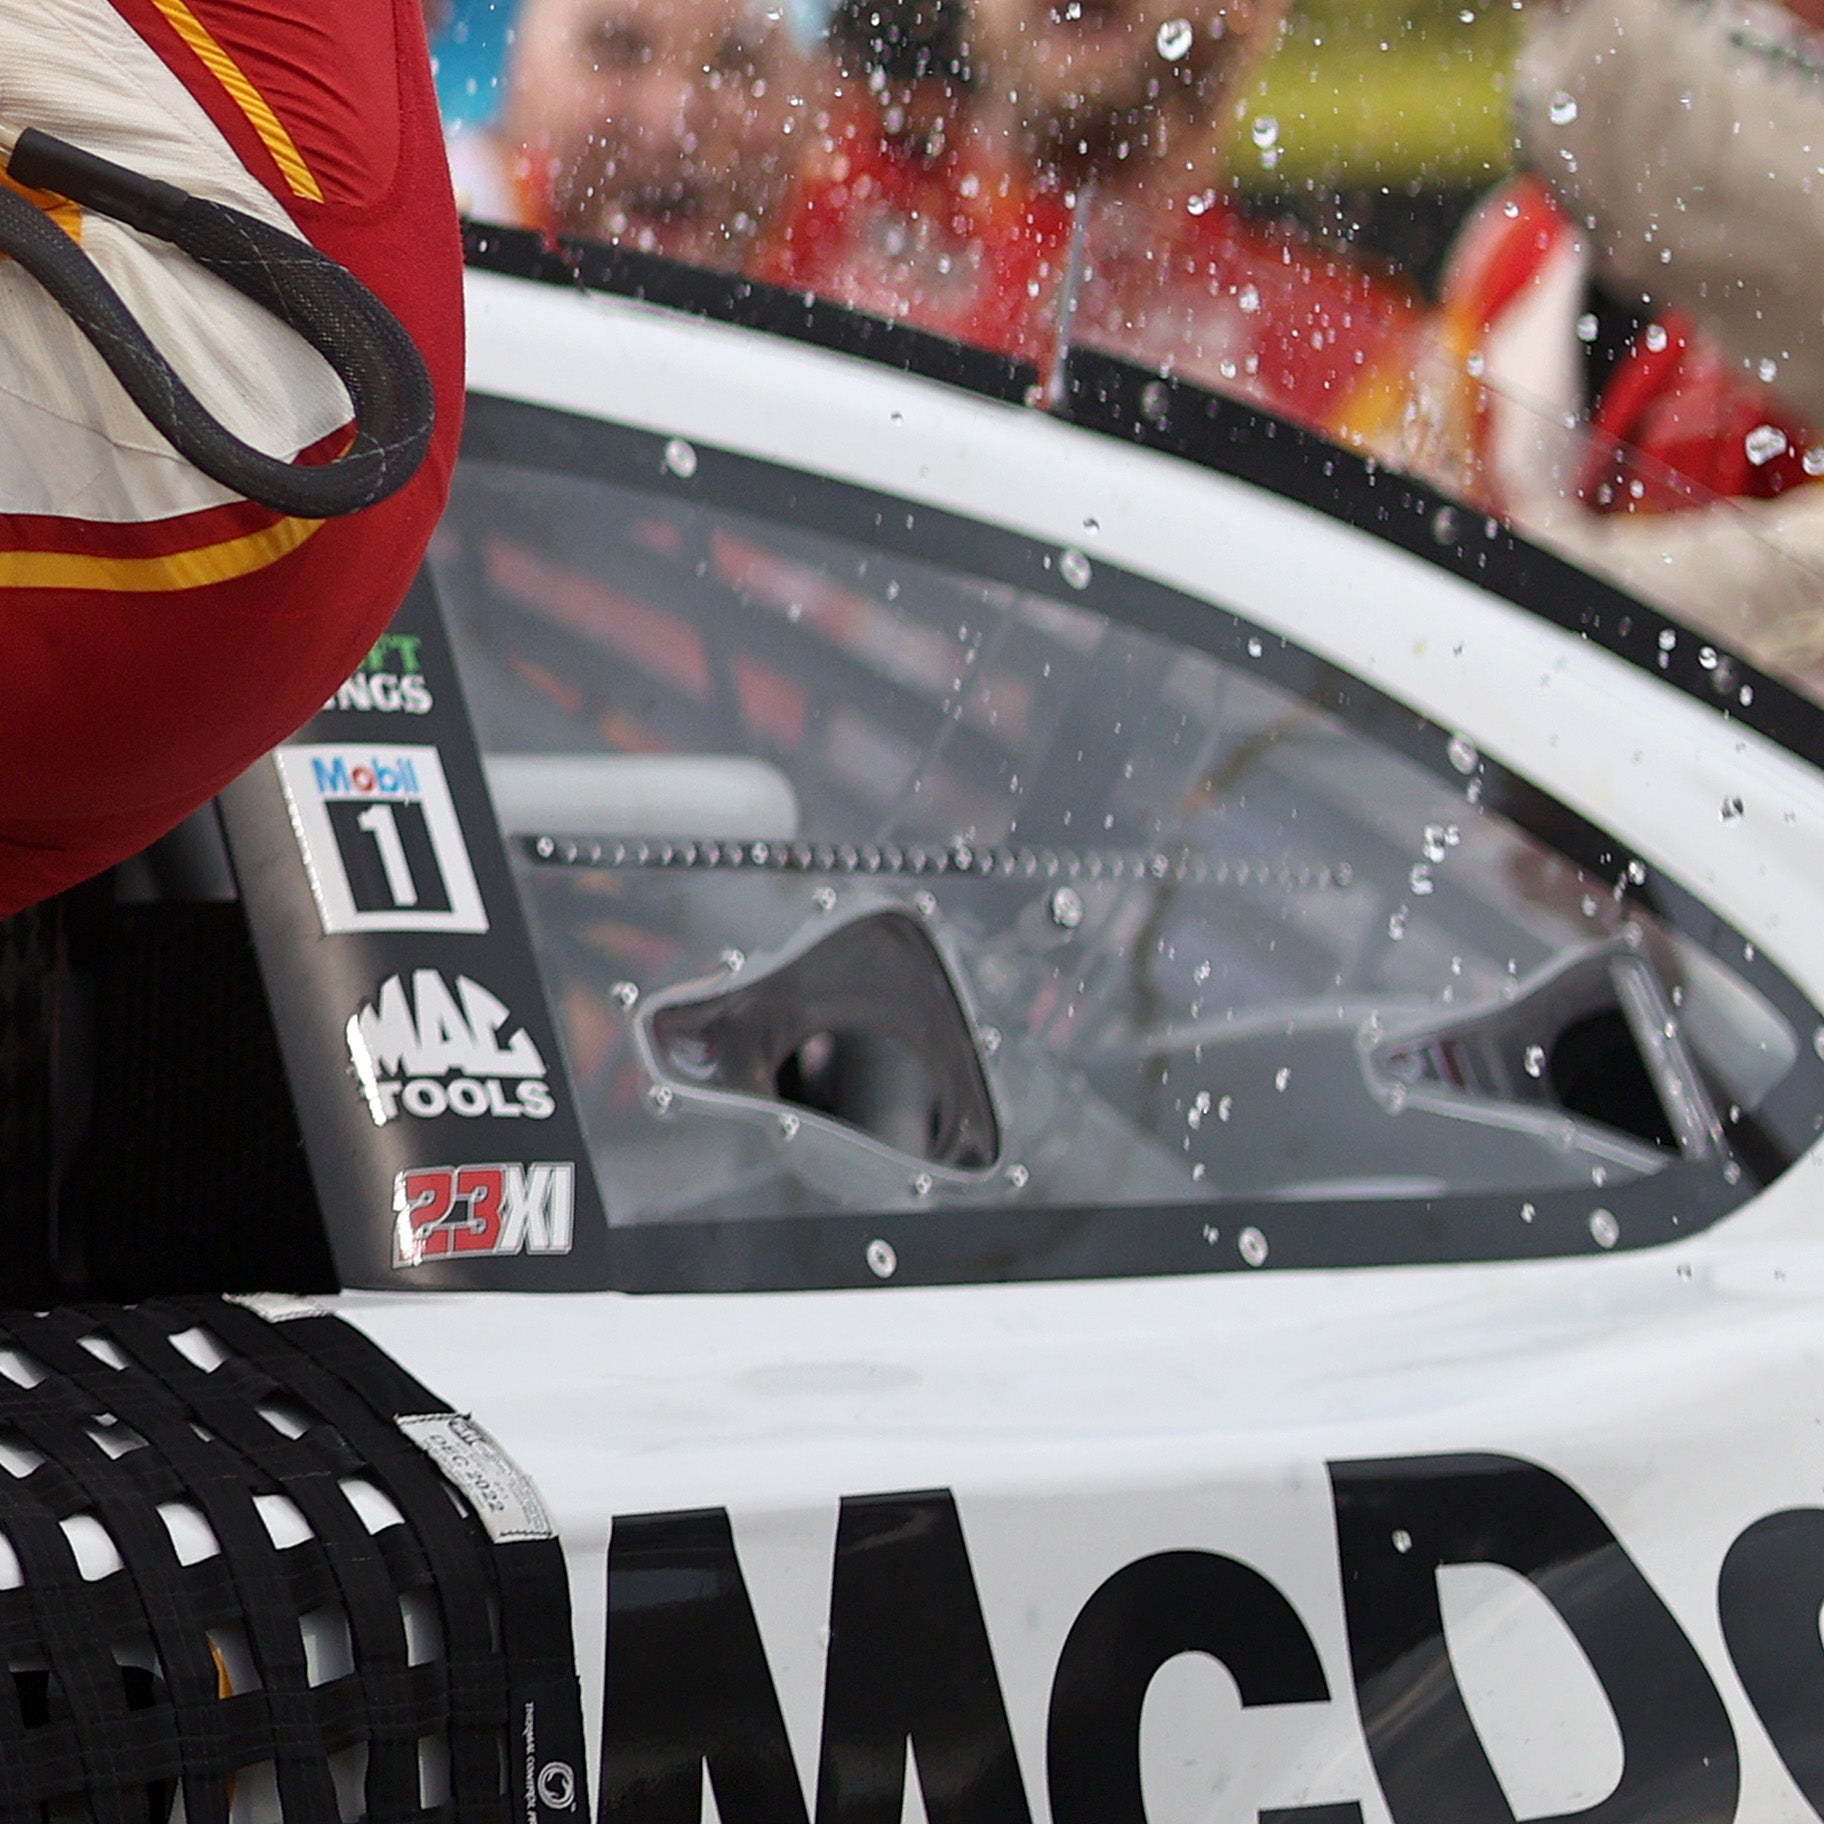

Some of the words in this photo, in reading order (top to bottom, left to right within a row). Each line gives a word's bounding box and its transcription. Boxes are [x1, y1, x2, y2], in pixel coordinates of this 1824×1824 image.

[311, 756, 420, 795] Mobil
[357, 803, 418, 907] 1
[348, 969, 547, 1078] MAC
[372, 1078, 555, 1120] TOOLS
[392, 1163, 575, 1268] 23XI
